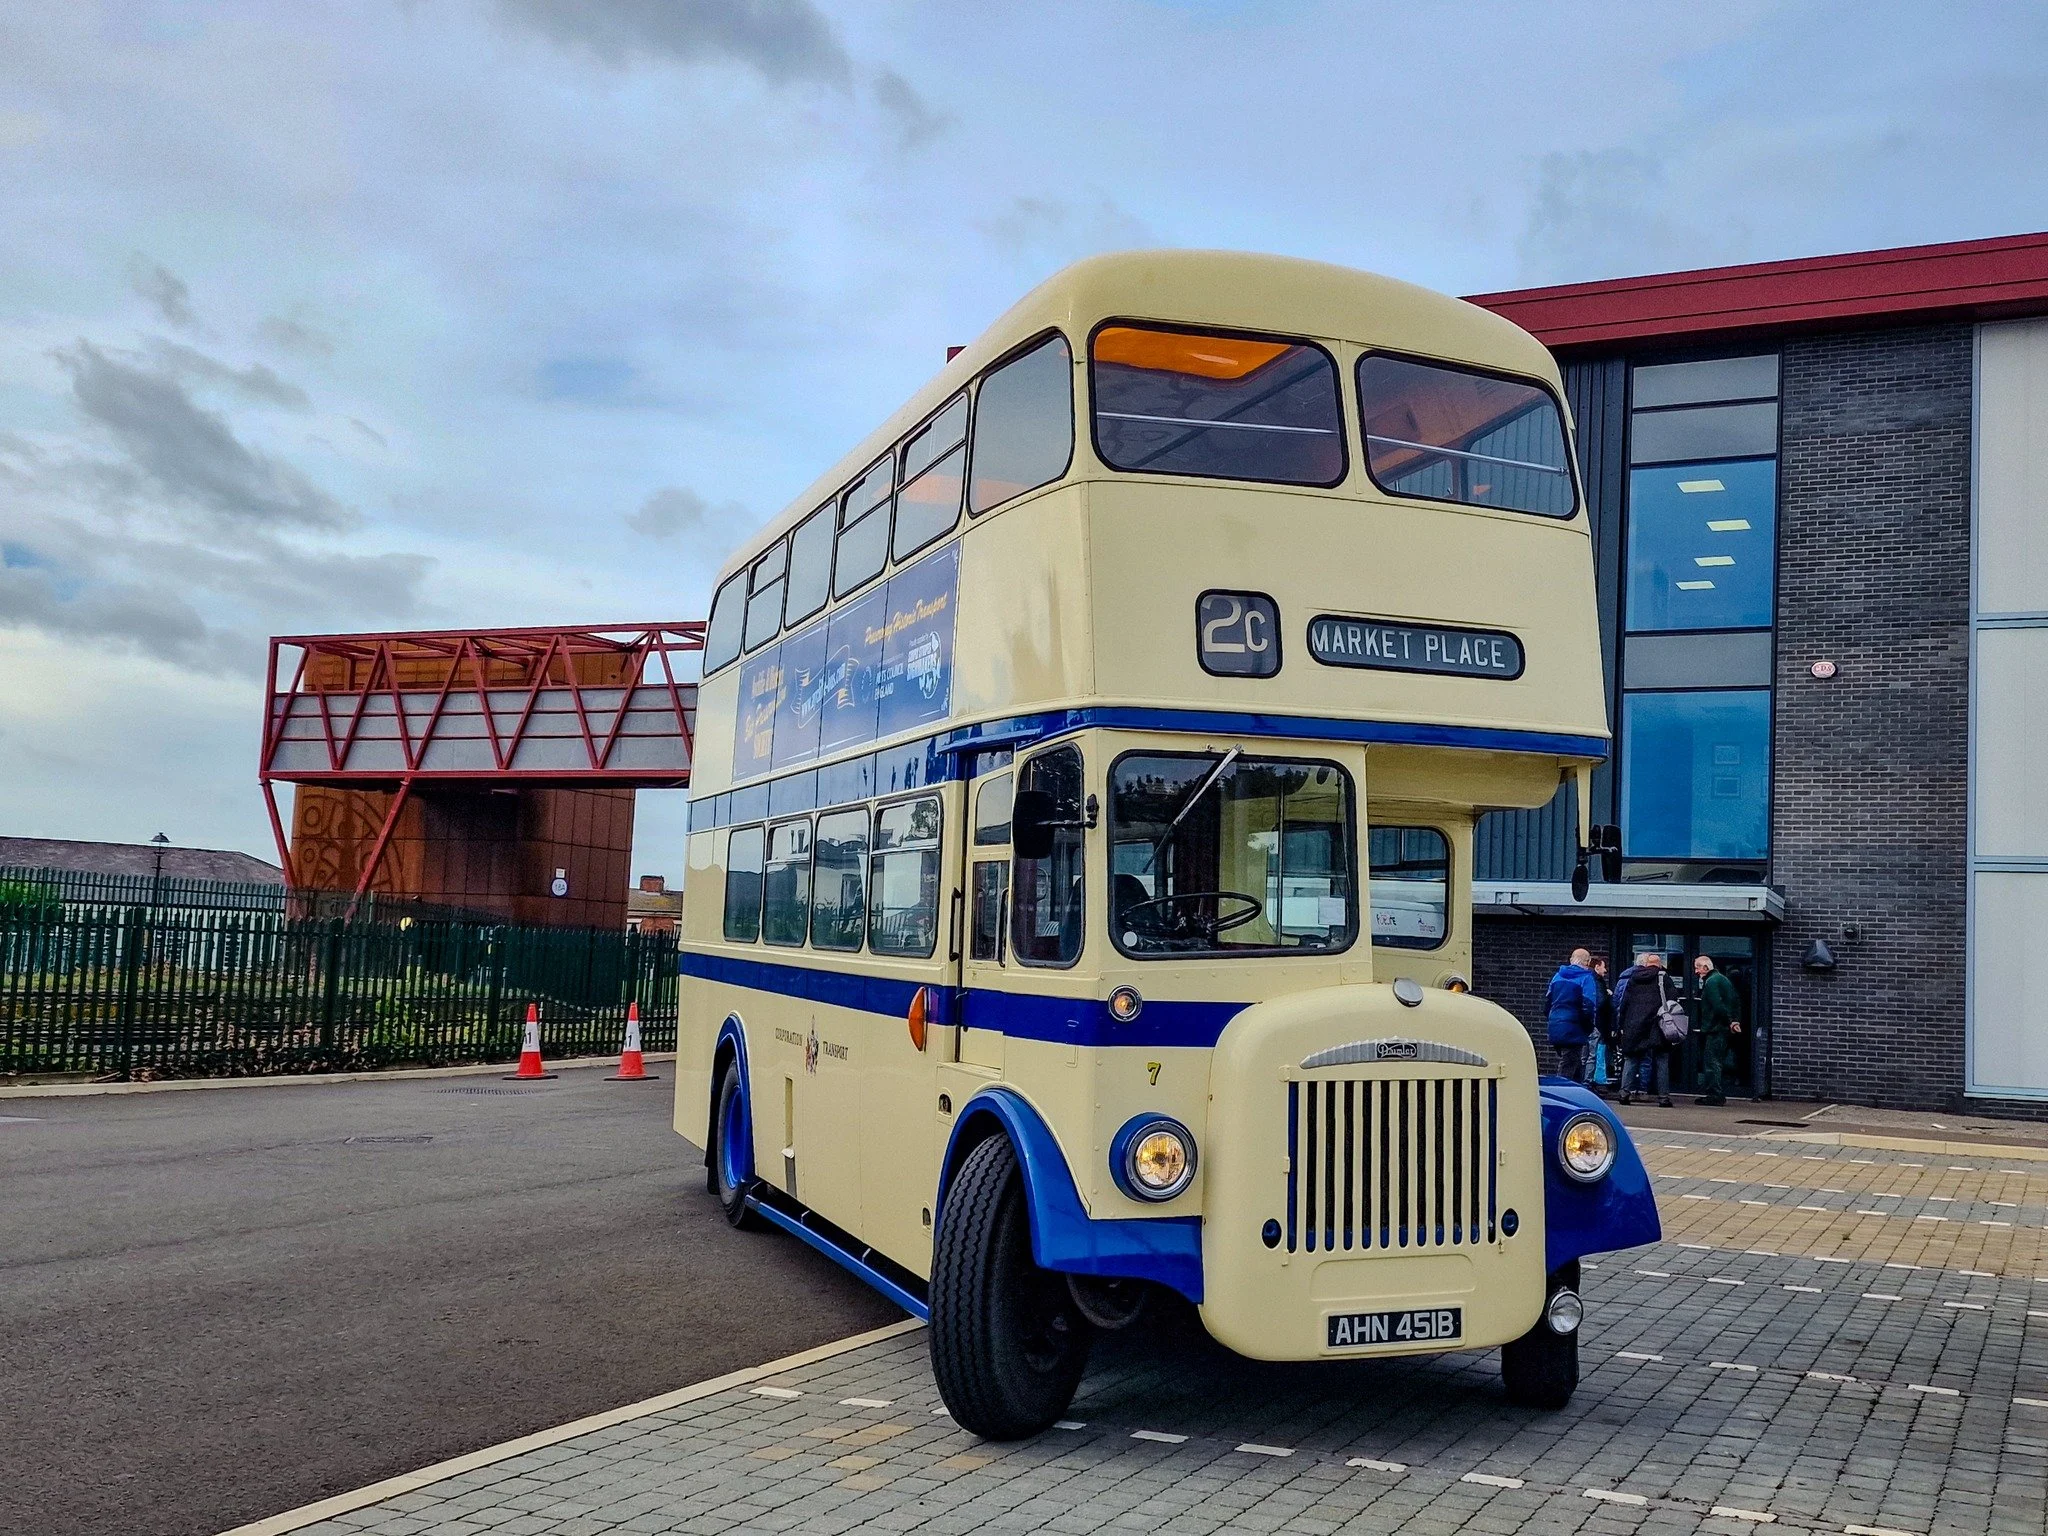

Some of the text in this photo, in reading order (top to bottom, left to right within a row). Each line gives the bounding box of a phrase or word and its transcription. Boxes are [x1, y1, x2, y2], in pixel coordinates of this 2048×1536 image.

[1311, 623, 1506, 669] MARKET PLACE
[1377, 1042, 1417, 1059] Daimler
[1147, 1061, 1162, 1086] 7
[1335, 1310, 1454, 1345] AHN 451B
